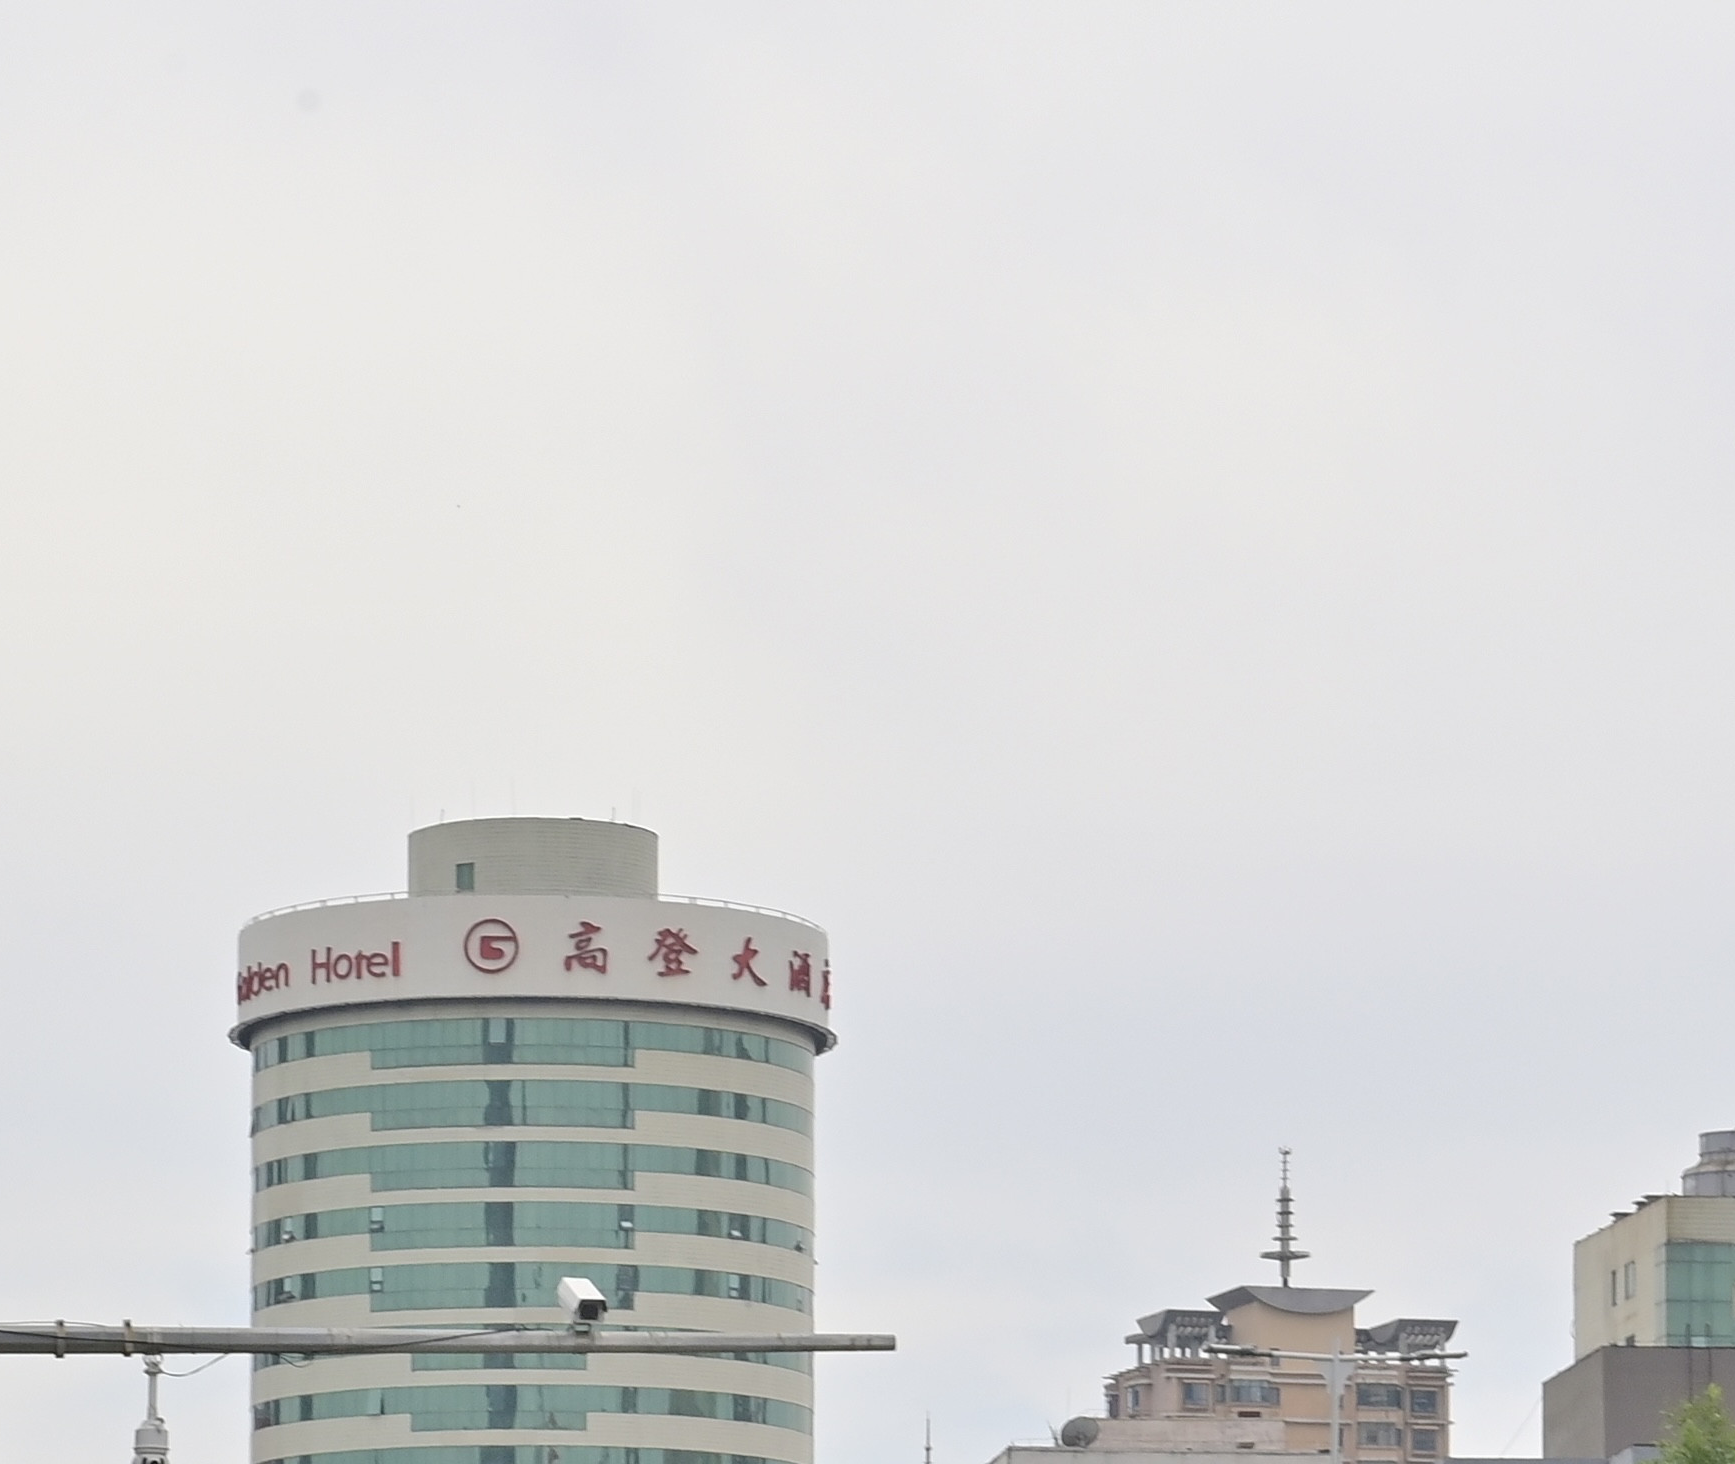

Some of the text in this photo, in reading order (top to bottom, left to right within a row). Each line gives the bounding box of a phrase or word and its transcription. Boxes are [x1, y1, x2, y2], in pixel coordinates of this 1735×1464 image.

[311, 941, 401, 985] Hotel
[564, 920, 832, 1010] 高登大酒
